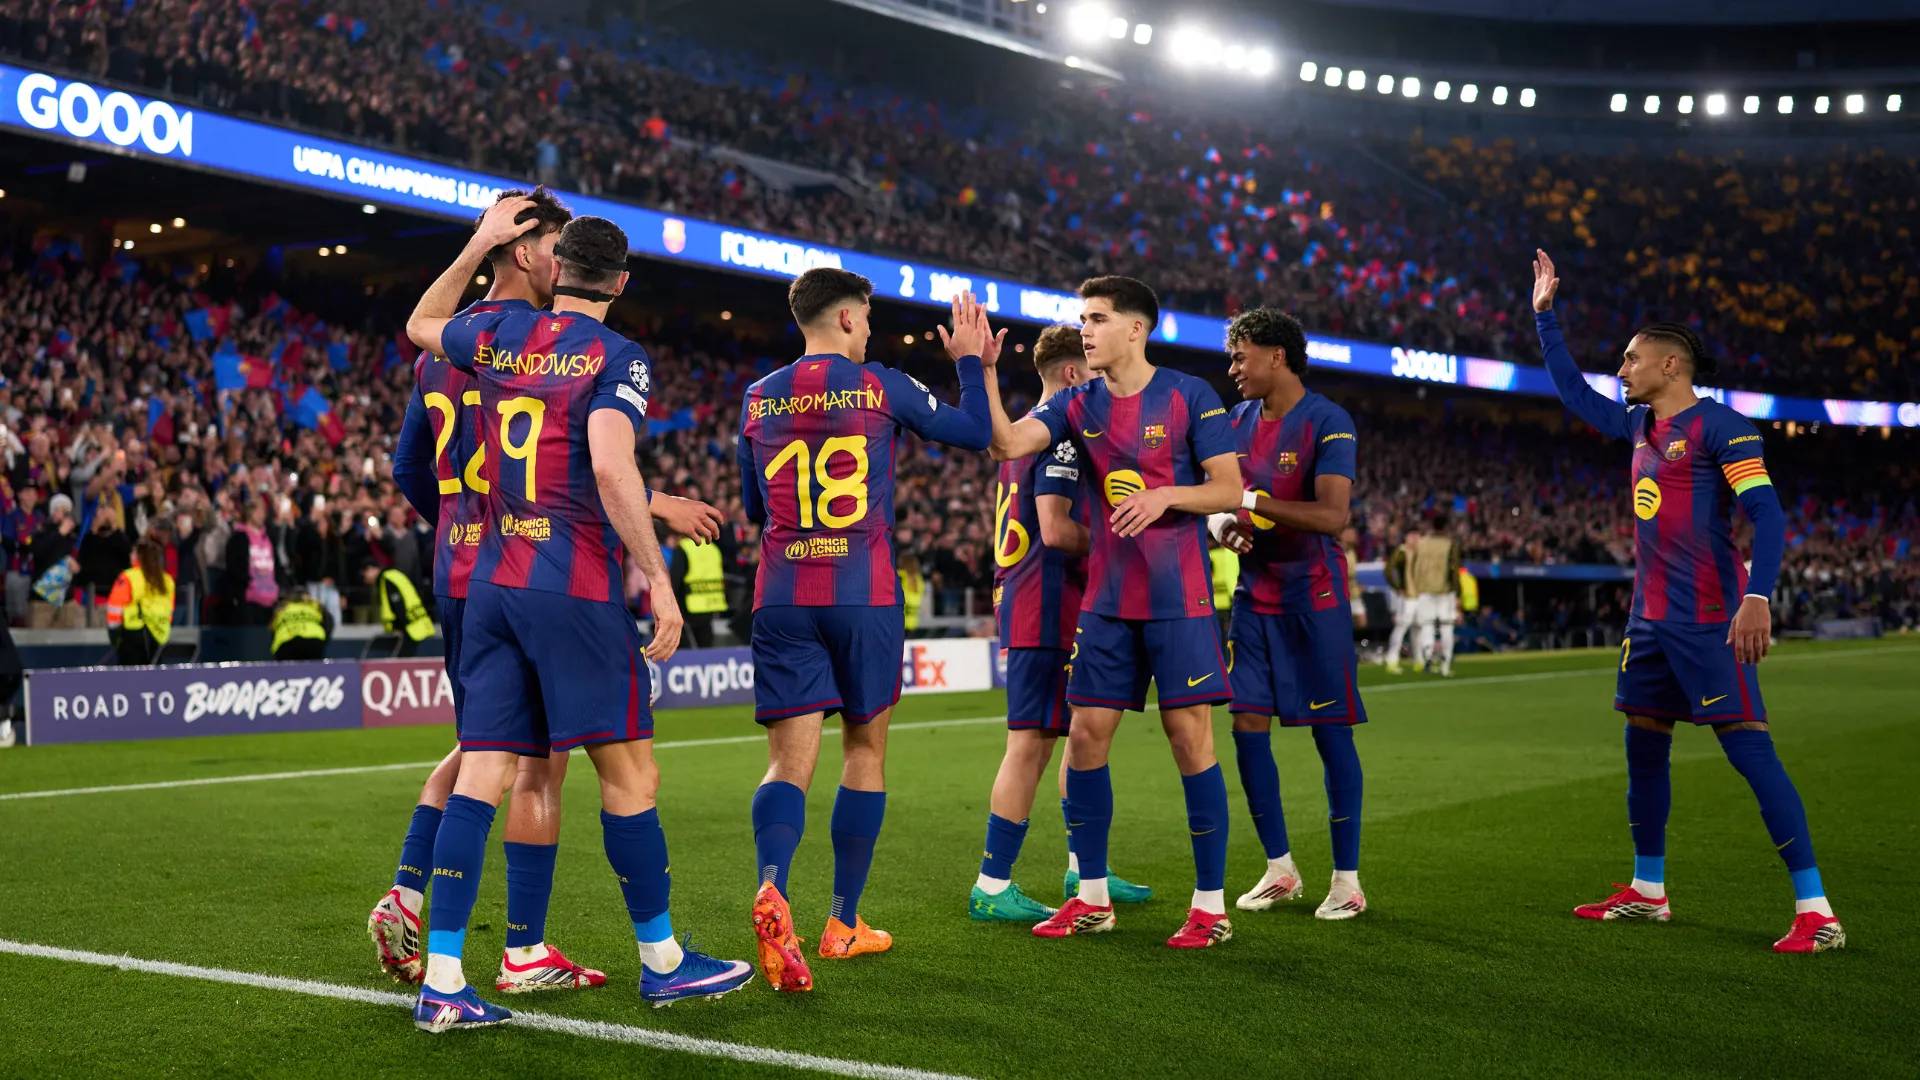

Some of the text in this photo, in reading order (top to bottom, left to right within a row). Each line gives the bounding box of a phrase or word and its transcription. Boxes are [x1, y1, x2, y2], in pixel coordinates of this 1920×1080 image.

[17, 73, 193, 157] GOOO
[900, 265, 915, 298] 2
[986, 282, 1000, 312] 1
[474, 344, 604, 377] EWANDOWSKI
[497, 396, 546, 503] 9
[764, 435, 869, 529] 18
[809, 537, 848, 546] UNHCR
[810, 546, 848, 555] ACNUR
[668, 658, 755, 698] crypto
[902, 646, 947, 687] dEx
[54, 675, 345, 723] ROAD TO BUDAPEST 26
[362, 668, 455, 717] QATA
